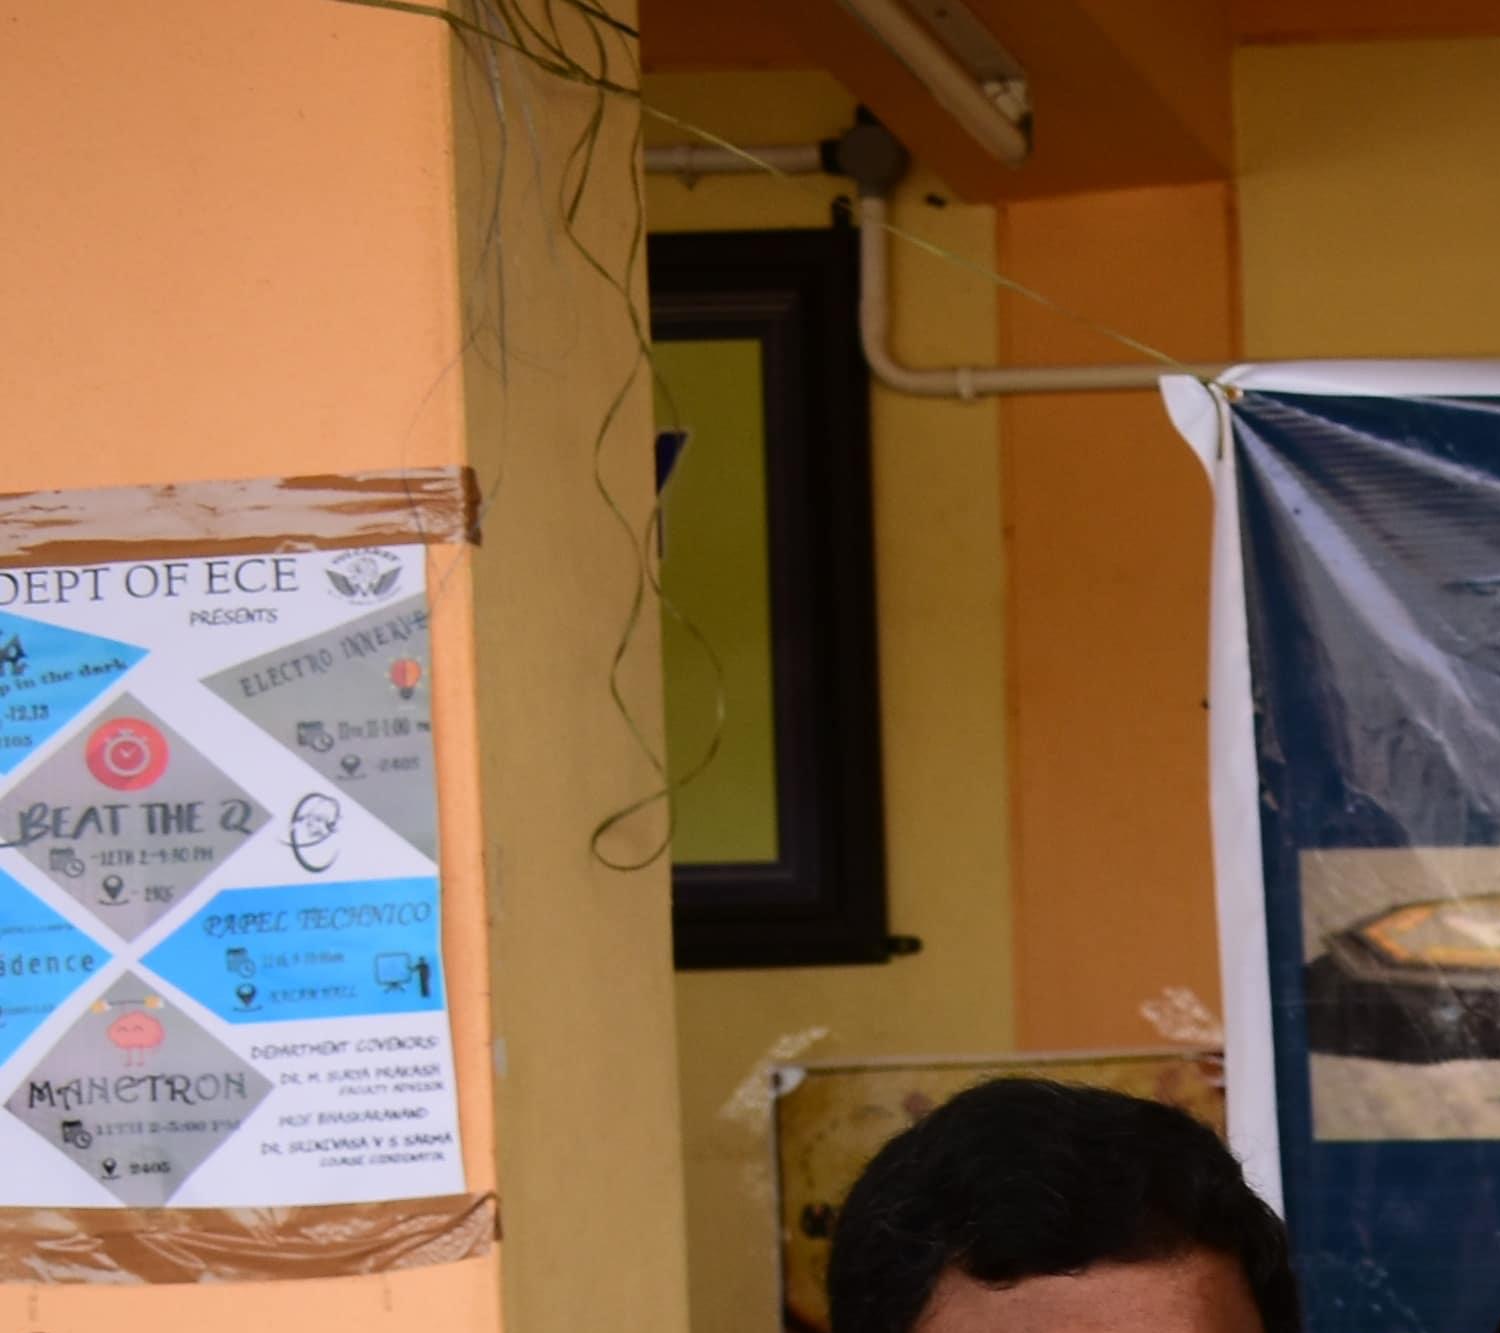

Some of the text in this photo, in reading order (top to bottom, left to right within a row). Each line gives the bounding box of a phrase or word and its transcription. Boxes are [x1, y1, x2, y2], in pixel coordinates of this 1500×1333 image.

[125, 563, 189, 599] OF
[204, 558, 298, 594] ECE
[190, 608, 278, 627] PRESENTS
[41, 671, 73, 685] the
[79, 657, 128, 678] dark
[240, 648, 333, 698] ELECTRO
[8, 799, 254, 844] BEAT THE Q
[203, 911, 289, 938] PAPEL
